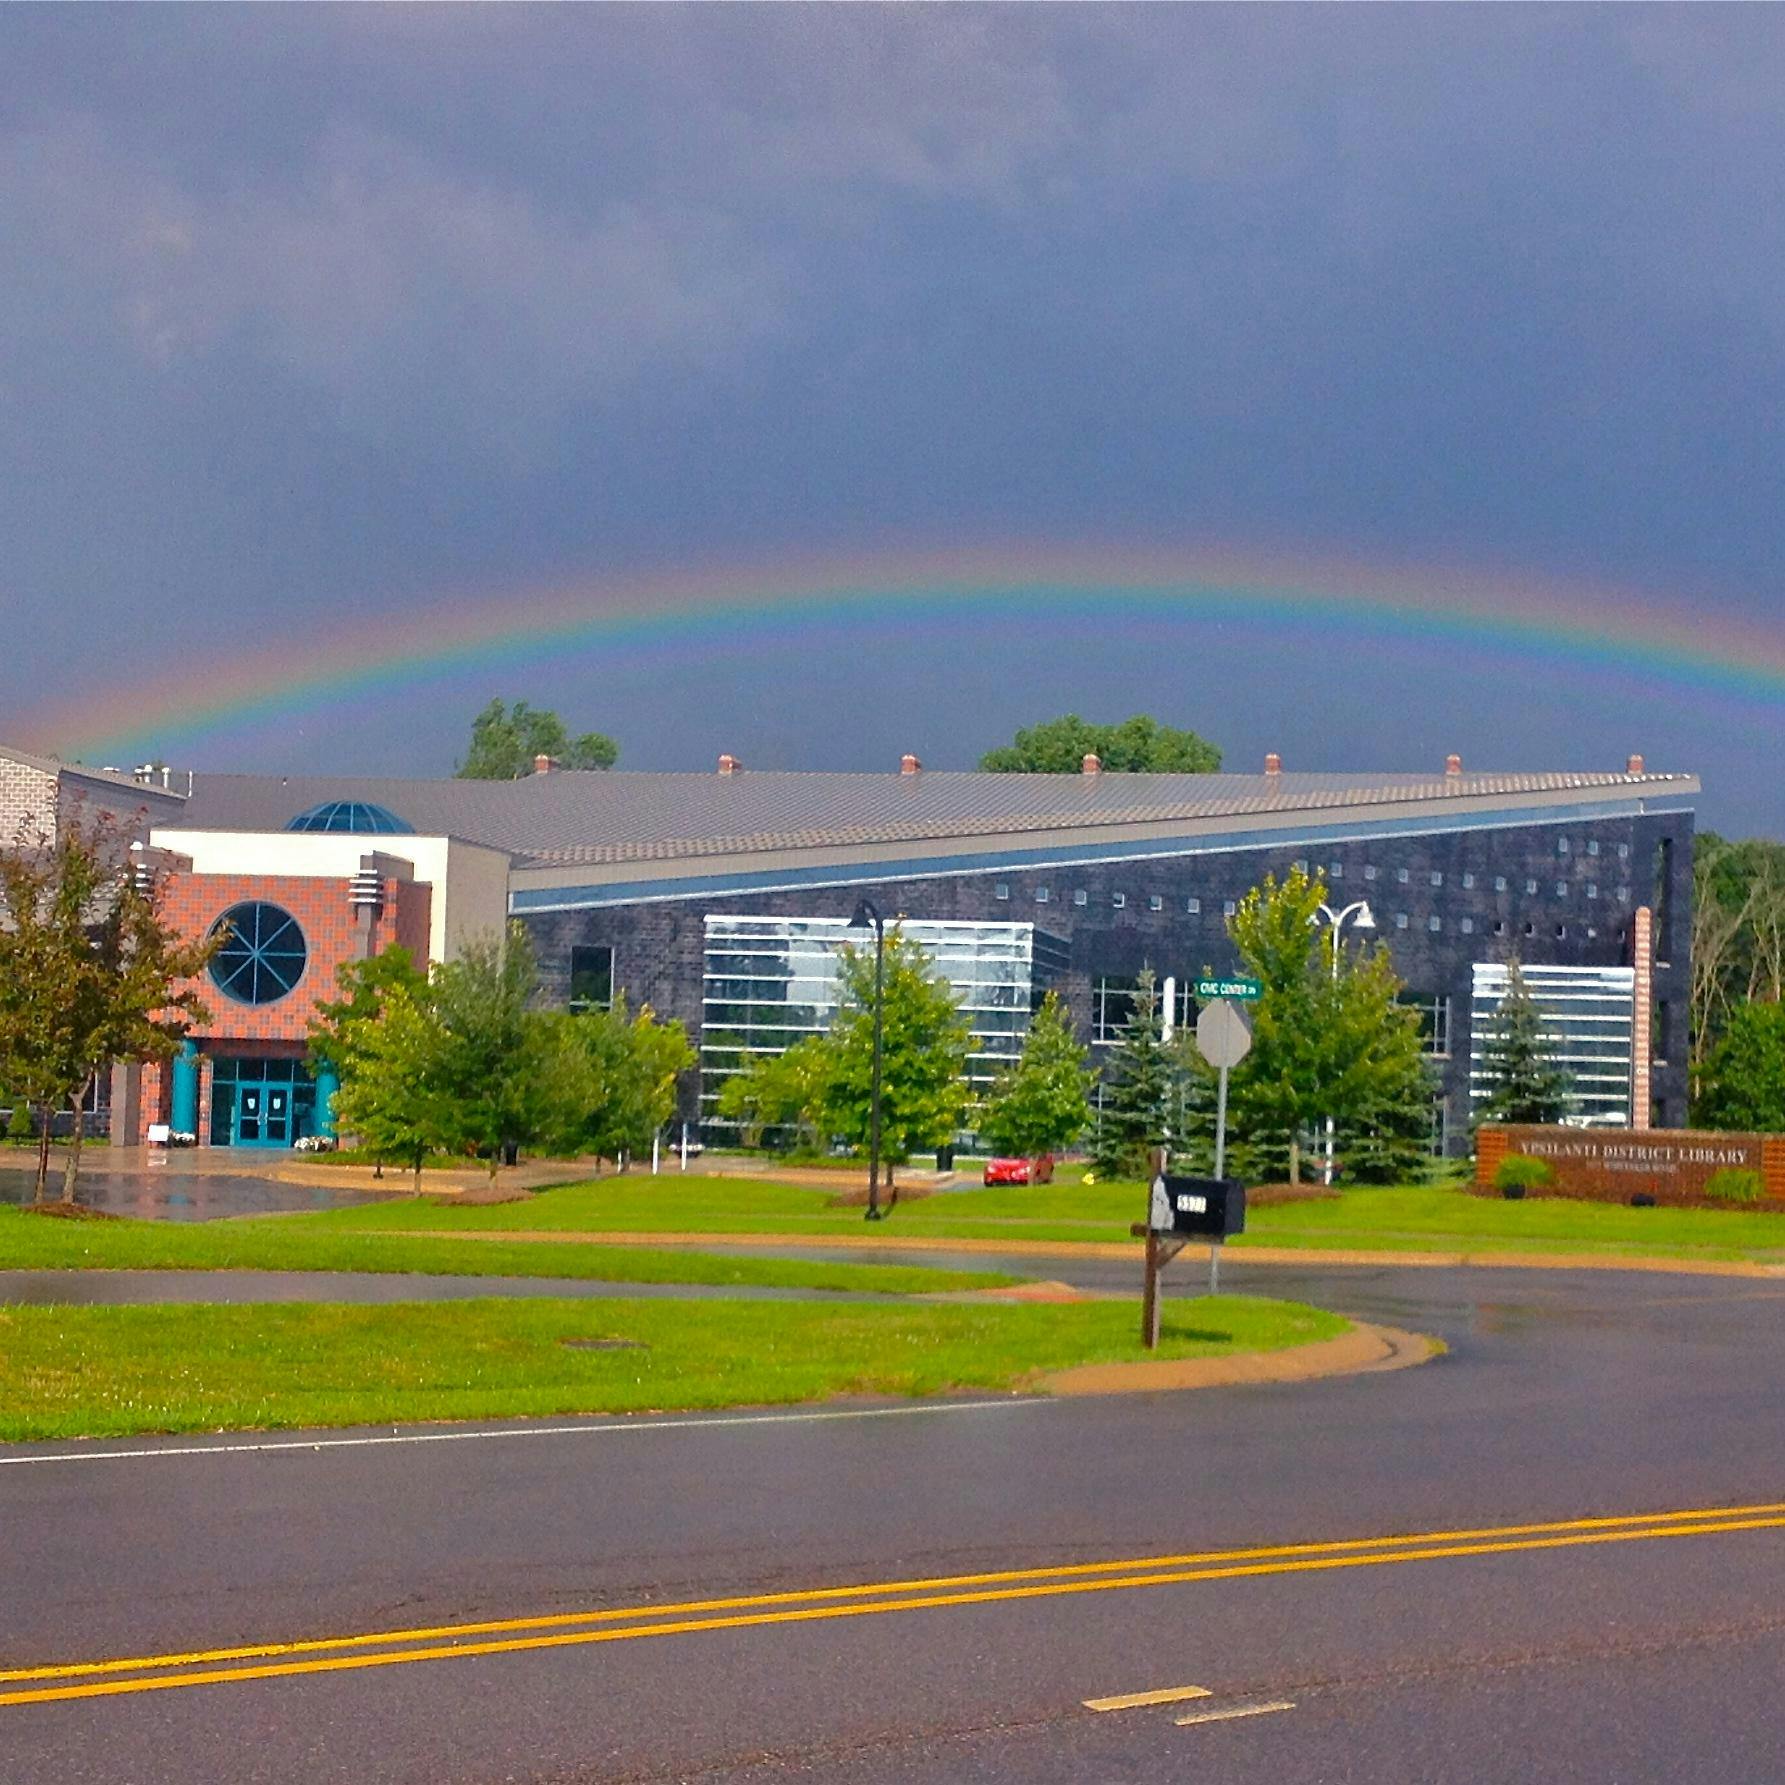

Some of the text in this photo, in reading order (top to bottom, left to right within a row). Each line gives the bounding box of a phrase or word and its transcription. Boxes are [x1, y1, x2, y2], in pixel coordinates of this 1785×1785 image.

[1220, 983, 1247, 995] CENTER
[1603, 1144, 1673, 1160] DISTRICT
[1679, 1148, 1748, 1164] LIBRARY
